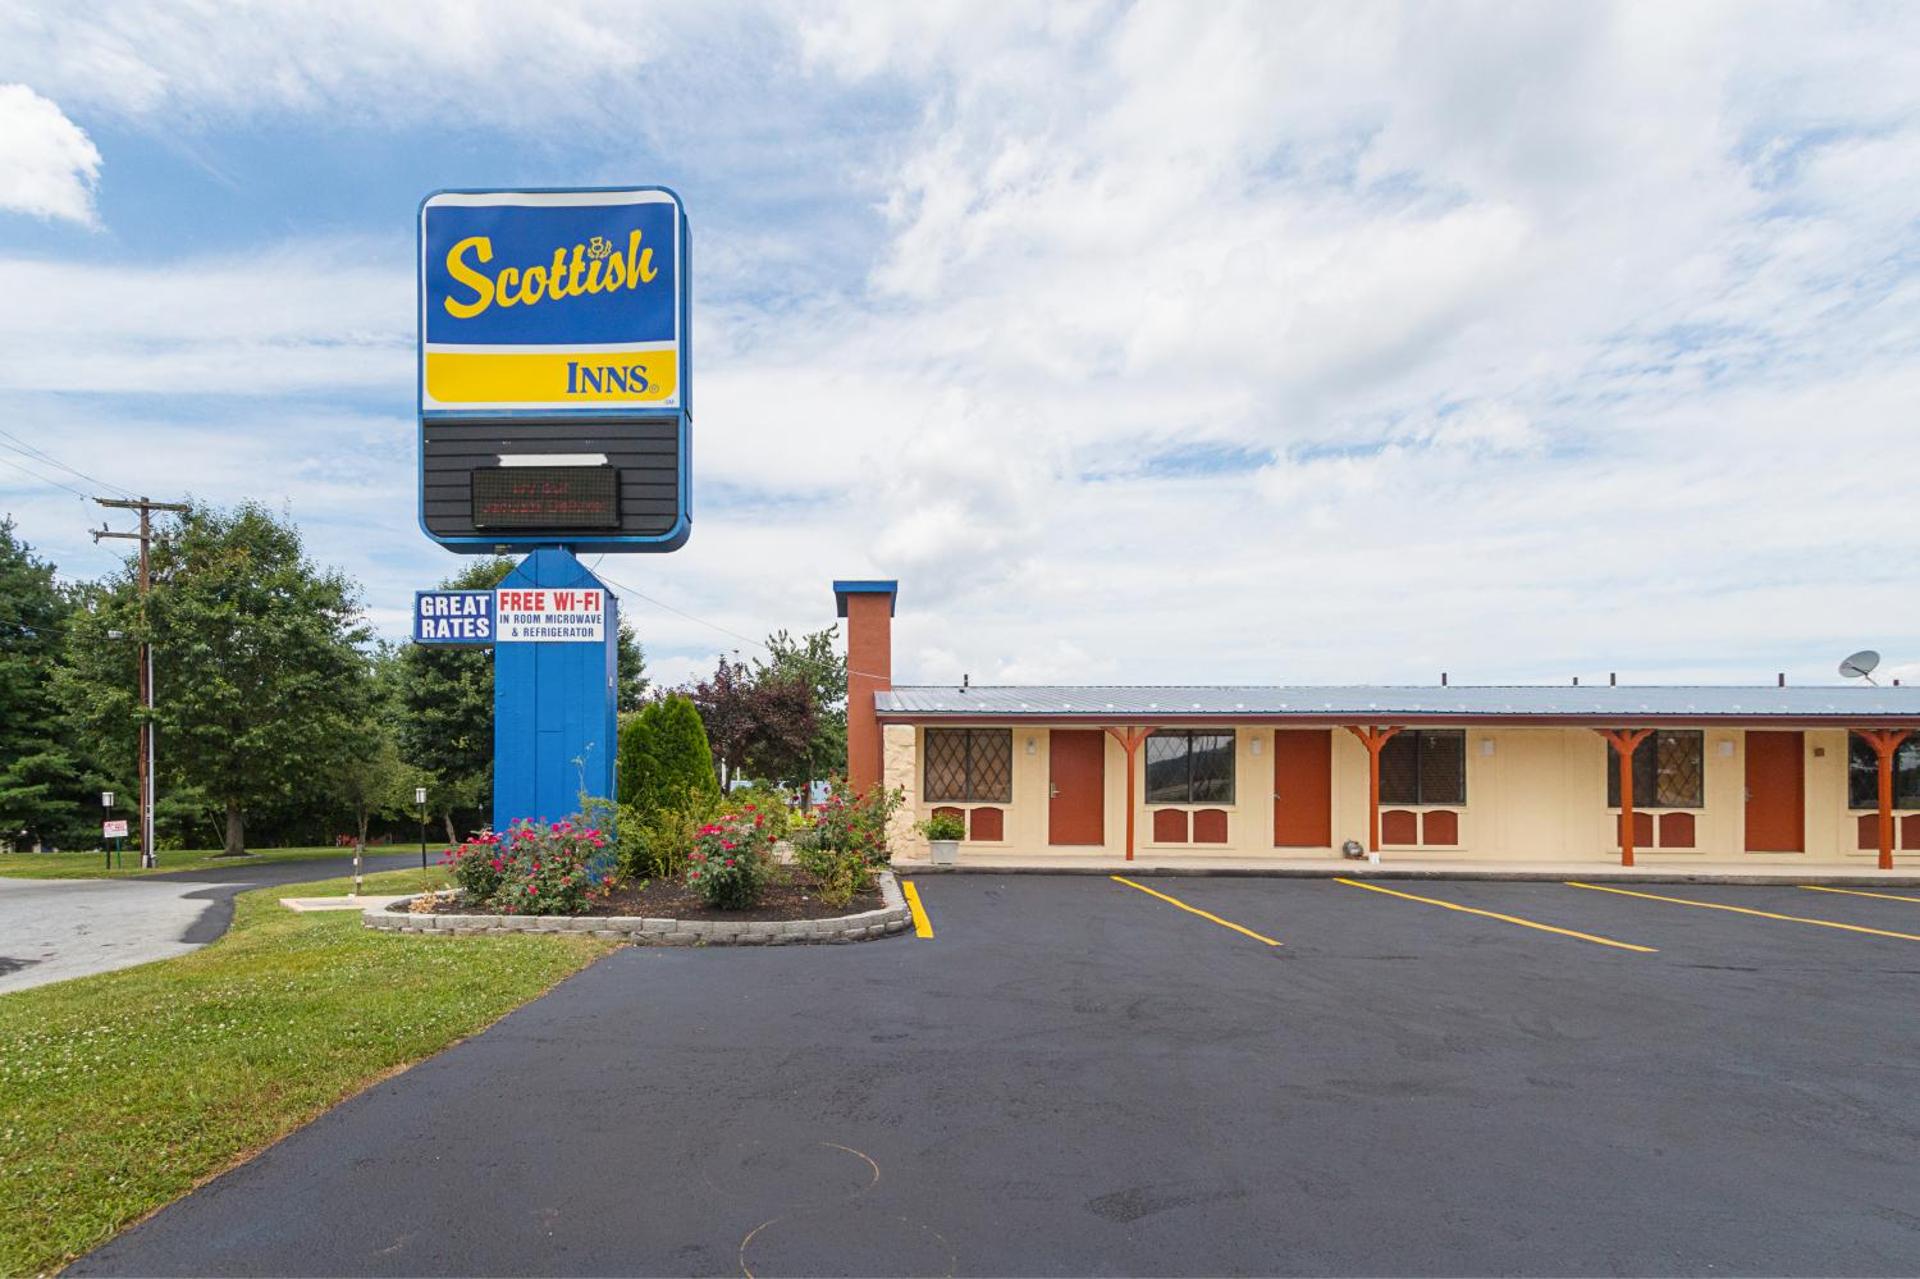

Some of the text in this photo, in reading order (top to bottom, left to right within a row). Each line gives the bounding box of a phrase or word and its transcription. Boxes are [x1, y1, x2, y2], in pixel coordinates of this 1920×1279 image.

[444, 229, 657, 319] Scottish
[566, 362, 649, 393] INNS
[420, 595, 490, 616] GREAT
[500, 592, 600, 611] FREE WI-FI
[421, 617, 490, 638] RATES
[500, 614, 602, 624] IN ROOM MICROWAVE
[511, 627, 594, 637] & REFRIGERATOR
